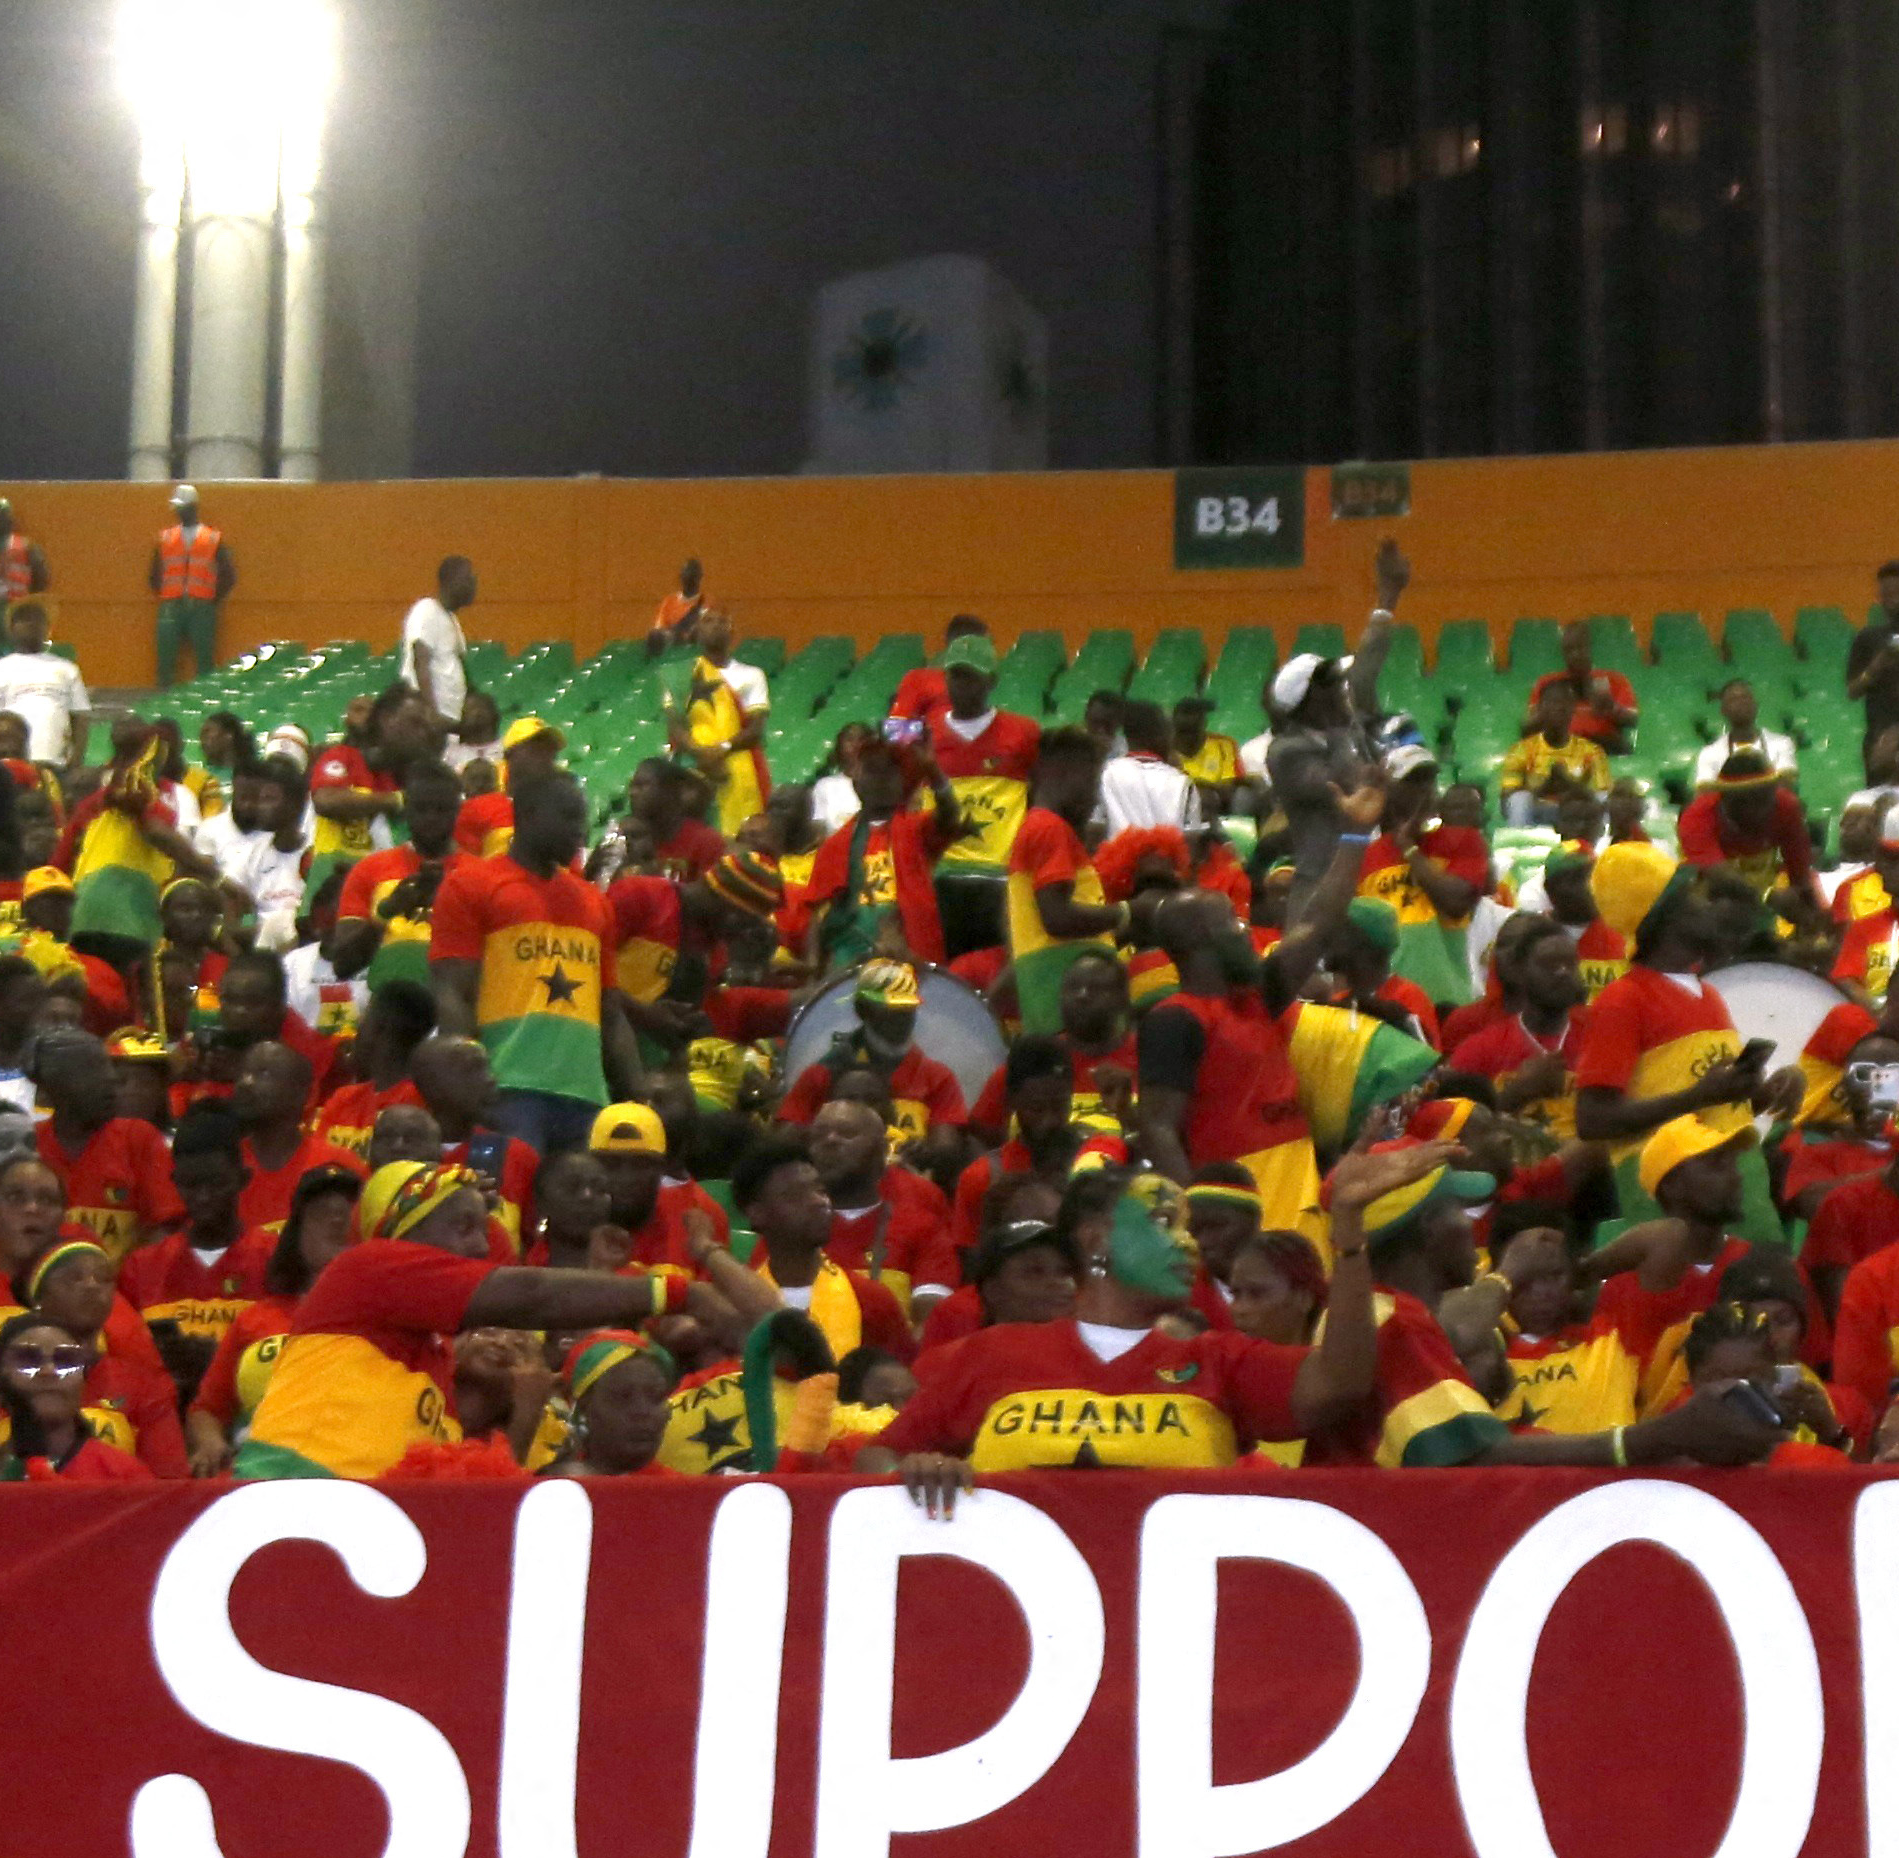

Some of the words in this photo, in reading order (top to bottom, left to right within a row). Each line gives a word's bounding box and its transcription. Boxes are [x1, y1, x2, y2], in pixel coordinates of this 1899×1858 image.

[1195, 496, 1281, 535] B34
[515, 933, 599, 967] GHANA
[174, 1305, 236, 1327] GHAN
[1515, 1362, 1578, 1386] ANA
[668, 1377, 743, 1413] HAN
[993, 1400, 1191, 1438] GHANA
